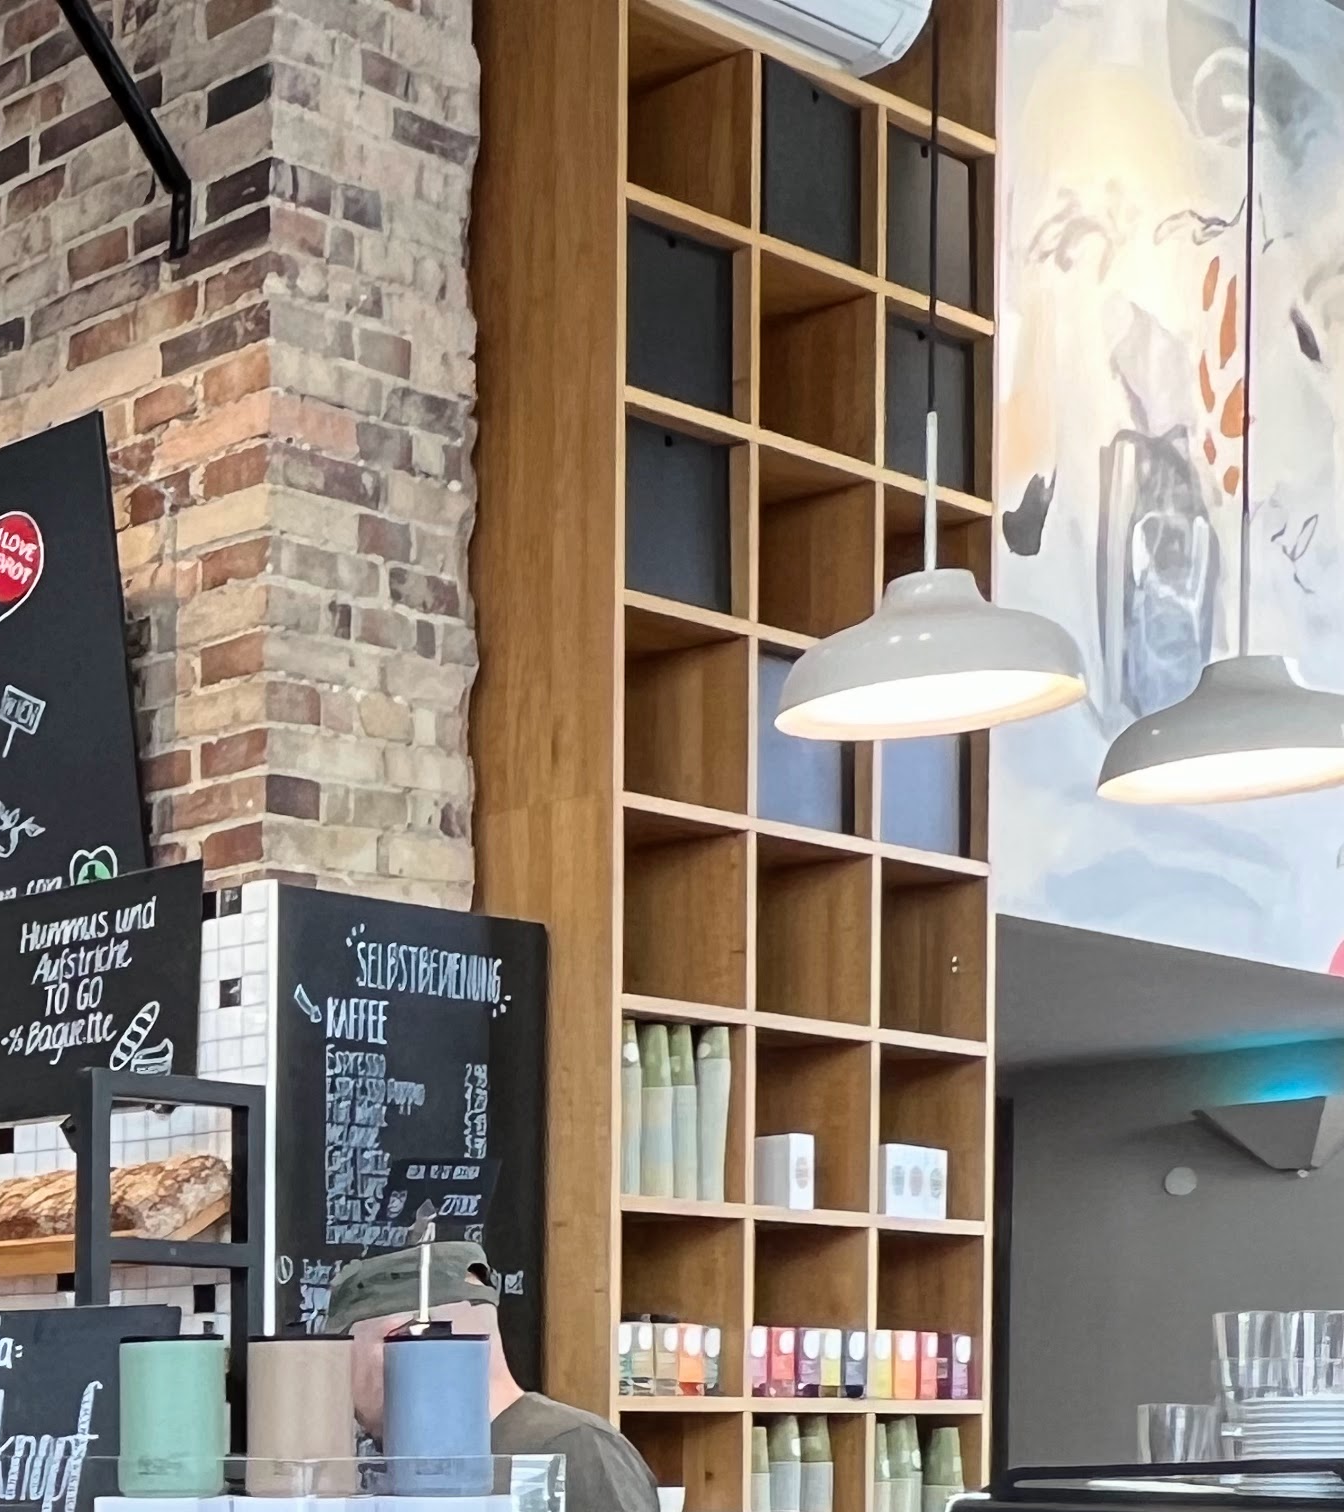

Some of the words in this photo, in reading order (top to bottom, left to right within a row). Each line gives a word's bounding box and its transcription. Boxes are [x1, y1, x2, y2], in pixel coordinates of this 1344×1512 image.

[3, 532, 38, 562] LOVE
[20, 910, 108, 954] Hummus
[115, 896, 157, 934] und
[30, 937, 132, 985] Aufstriche
[356, 942, 502, 1004] SELBSTBEDIENUNG
[44, 981, 70, 1017] TO
[77, 976, 103, 1011] GO
[325, 996, 389, 1045] KAFFEE
[25, 1013, 117, 1065] Baguette
